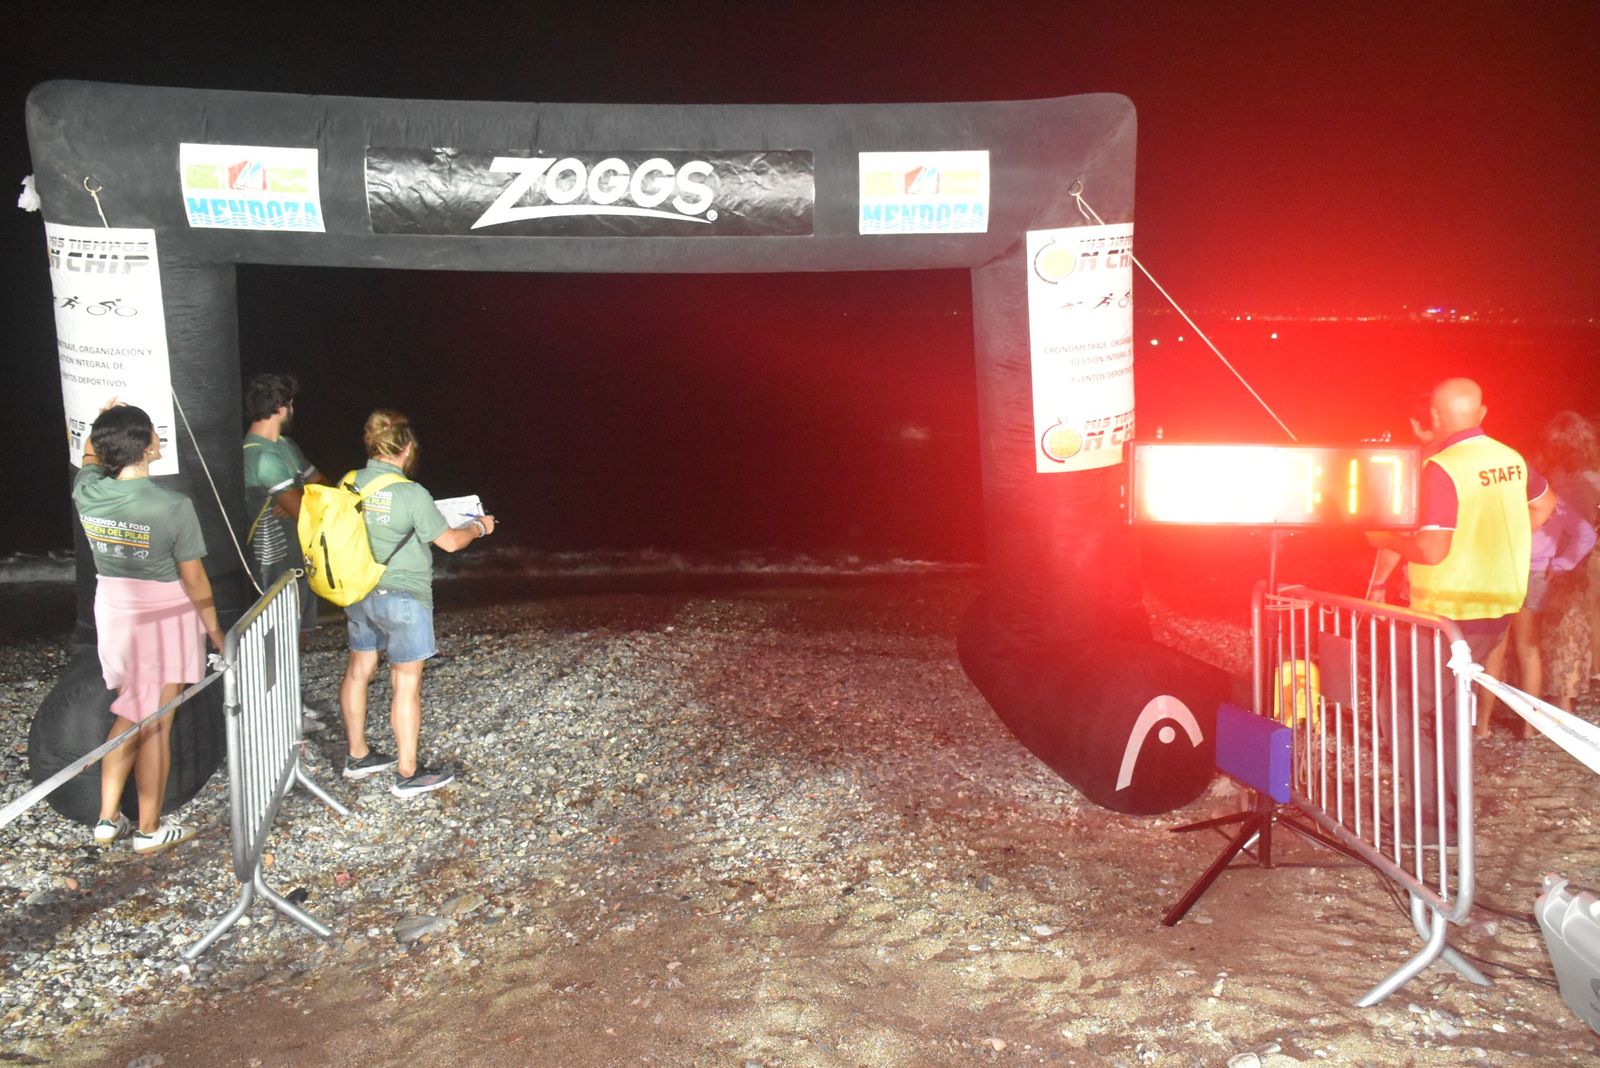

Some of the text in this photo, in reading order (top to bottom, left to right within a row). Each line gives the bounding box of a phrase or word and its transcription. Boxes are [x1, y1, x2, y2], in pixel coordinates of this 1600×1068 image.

[470, 156, 719, 229] ZOGGS
[187, 197, 320, 228] MENDOZA
[863, 202, 985, 231] MENDOZA
[75, 358, 111, 370] INTEGRAL
[113, 361, 125, 370] DE
[78, 376, 127, 388] DEPORTIVOS
[1478, 465, 1522, 487] STAFF
[107, 528, 124, 537] DEL
[124, 531, 150, 541] PILAR
[118, 521, 128, 529] AL
[129, 523, 150, 532] FOSO
